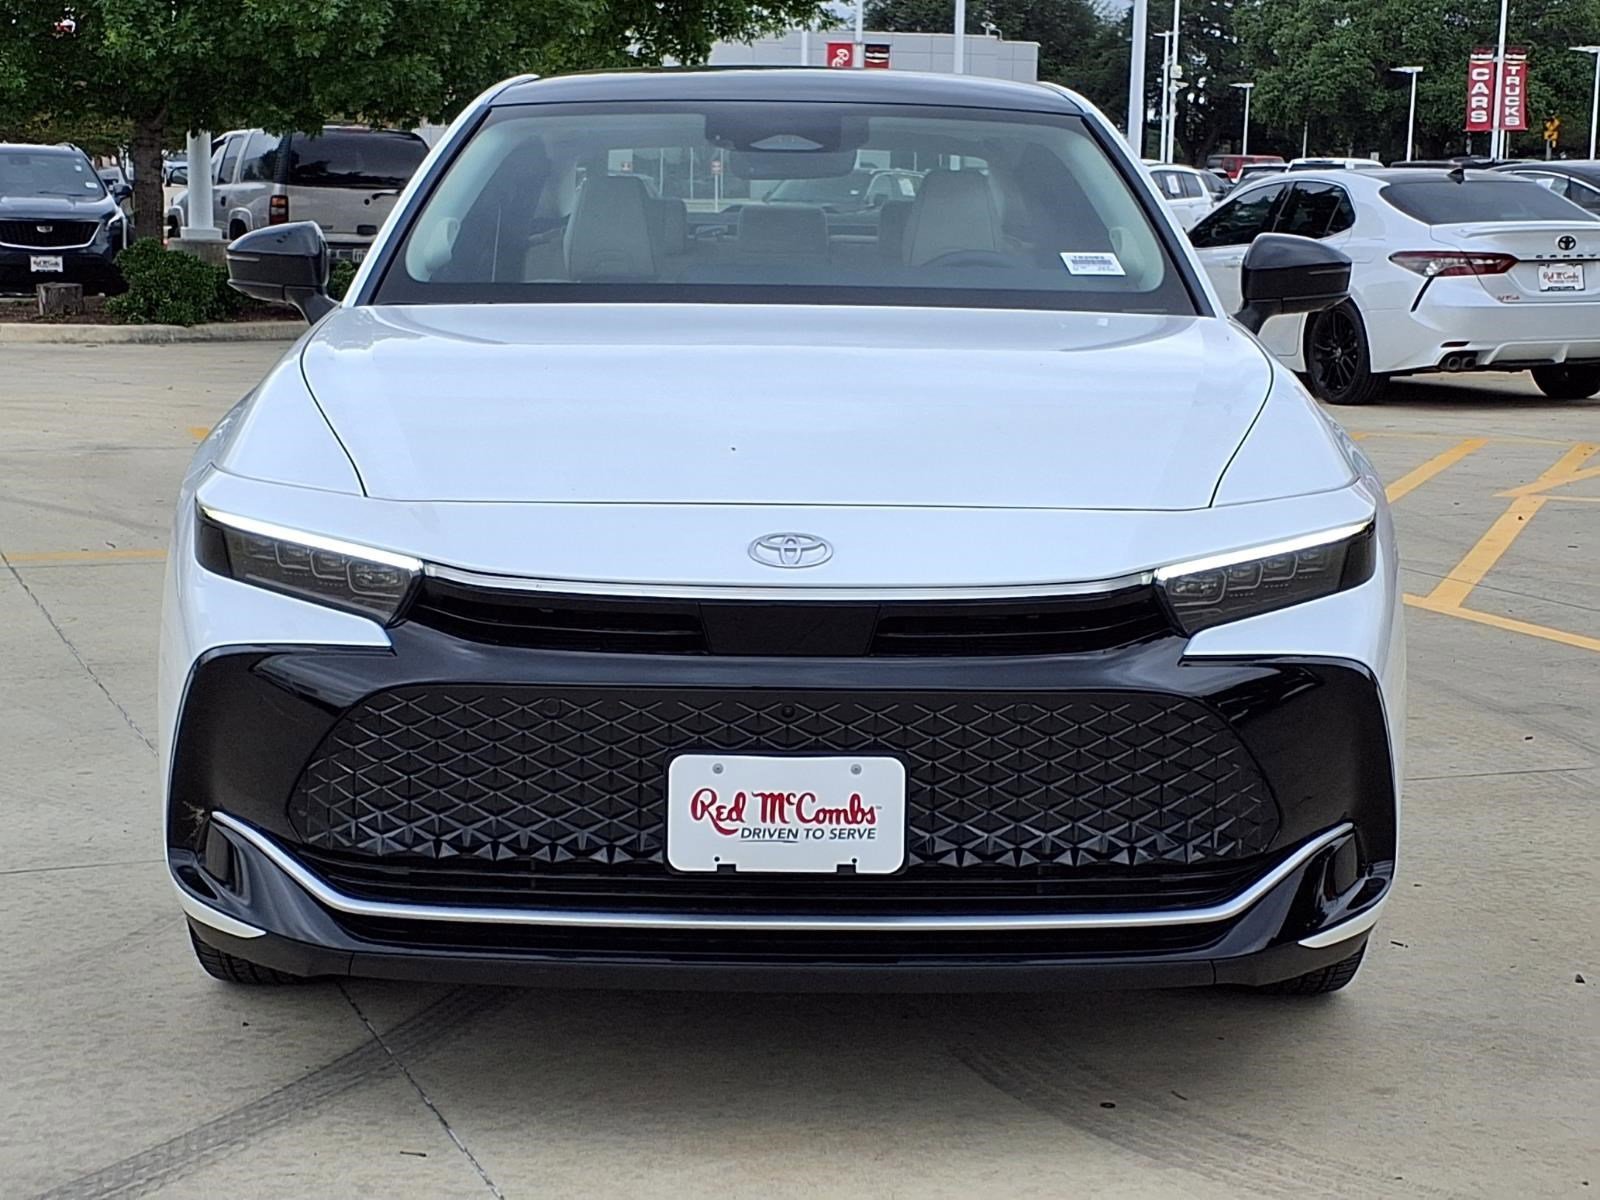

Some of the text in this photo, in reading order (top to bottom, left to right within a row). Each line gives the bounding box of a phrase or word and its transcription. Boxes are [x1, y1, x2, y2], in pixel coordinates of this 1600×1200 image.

[1470, 67, 1490, 123] CARS
[1504, 65, 1521, 126] TRUCKS
[690, 787, 877, 836] Red McCombs
[740, 827, 877, 840] DRIVEN TO SERVE
